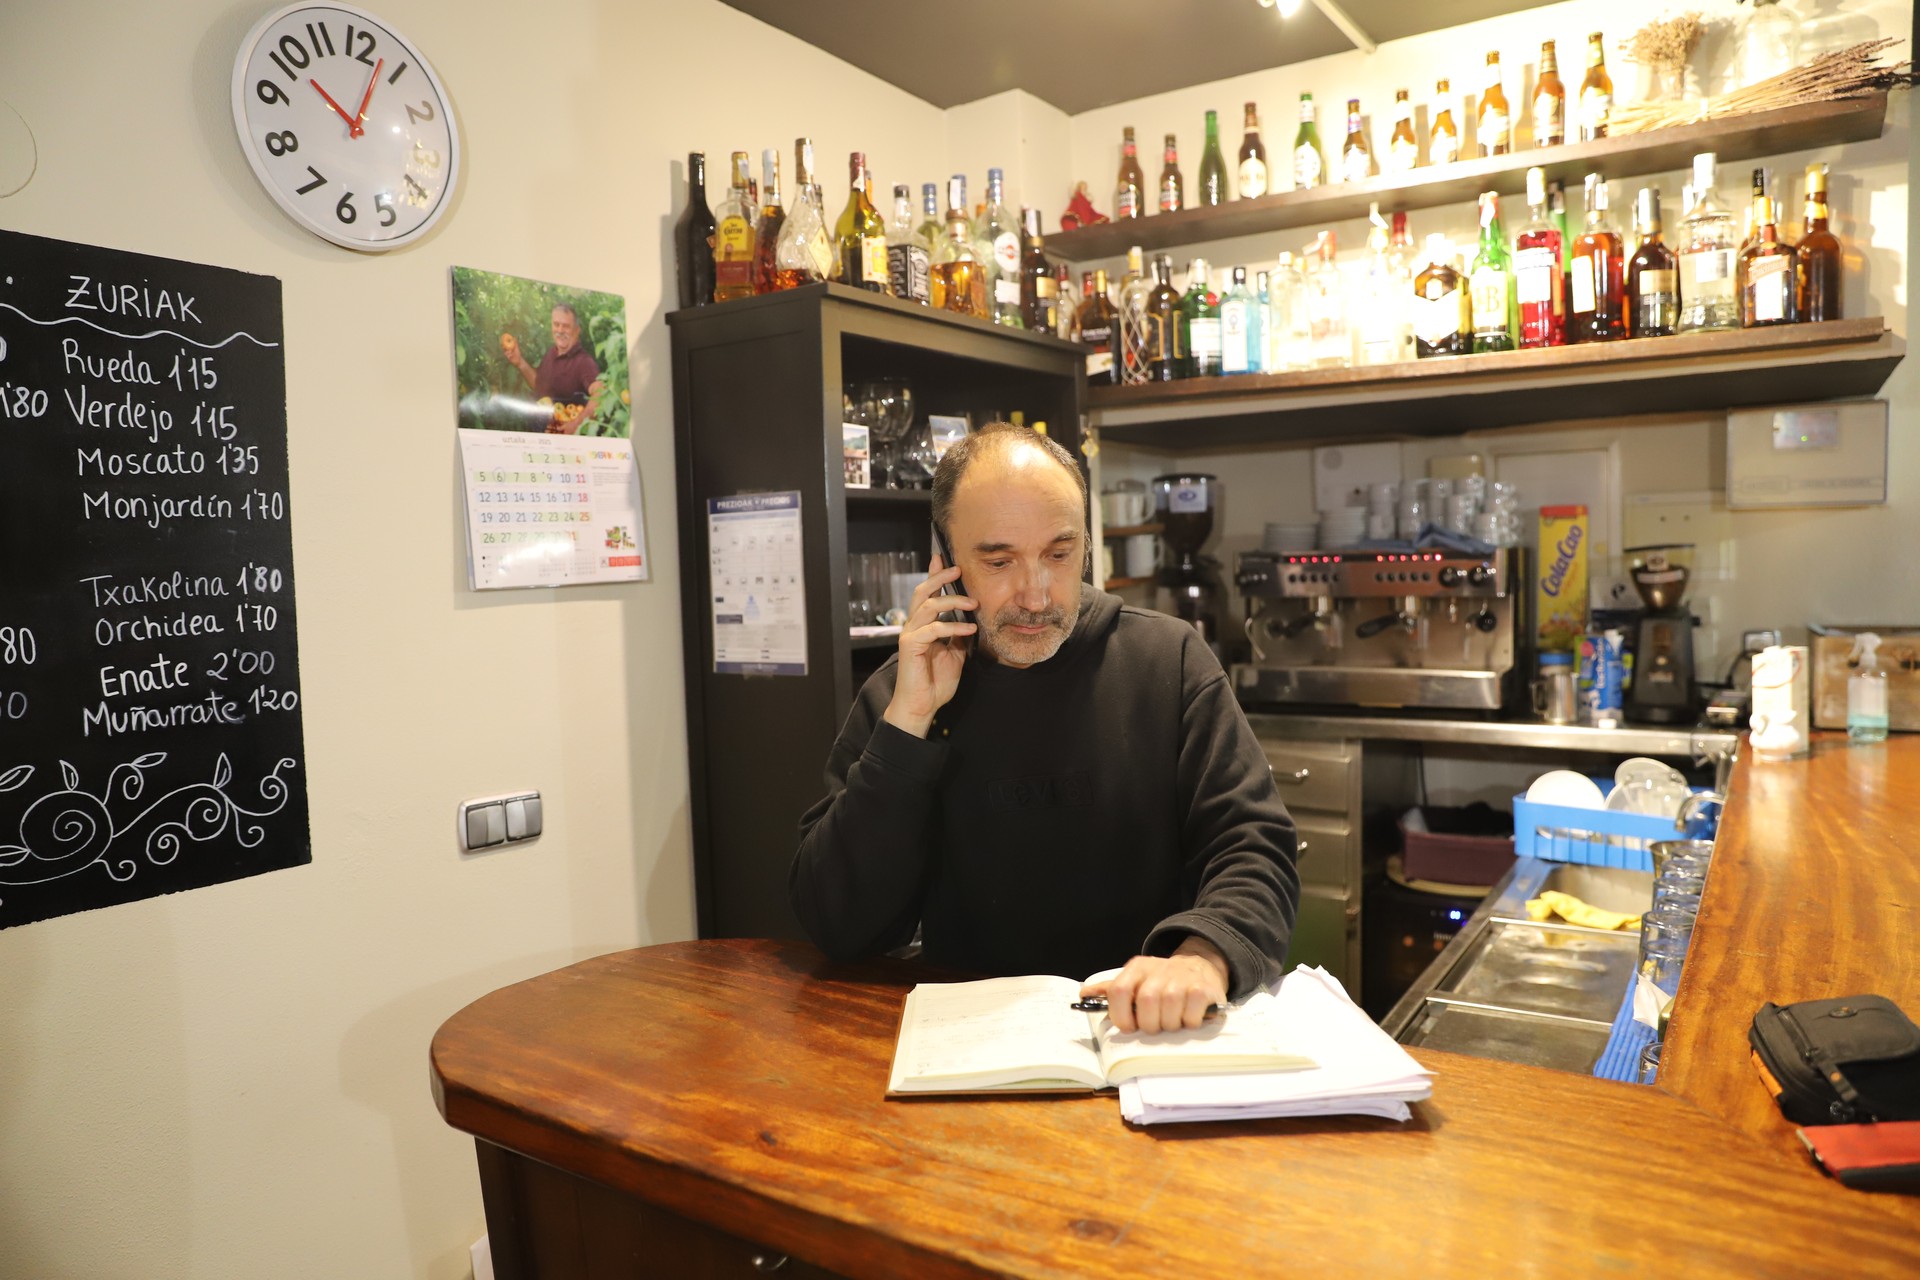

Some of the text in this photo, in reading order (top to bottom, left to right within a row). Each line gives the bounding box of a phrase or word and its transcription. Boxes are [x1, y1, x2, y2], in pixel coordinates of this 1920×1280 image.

[269, 35, 310, 81] 10
[345, 24, 376, 67] 12
[388, 61, 407, 85] 1
[256, 79, 290, 107] 9
[404, 100, 434, 125] 2
[265, 130, 299, 157] 8
[295, 165, 328, 195] 7
[336, 192, 357, 224] 6
[374, 192, 396, 227] 5
[62, 338, 217, 391] Rueda 1'15
[64, 385, 237, 443] Verdejo 1'15
[78, 444, 258, 476] Moscato 1'35
[528, 454, 534, 463] 1
[543, 454, 550, 463] 2
[560, 454, 566, 464] 3
[575, 456, 581, 464] 4
[480, 472, 486, 482] 5
[497, 472, 503, 482] 6
[513, 473, 520, 482] 7
[530, 473, 537, 482] 8
[546, 473, 552, 483] 9
[560, 474, 571, 483] 10
[576, 474, 586, 483] 11
[84, 489, 283, 528] Monjardín 1'70
[479, 492, 588, 503] 12 13 14 15 16 17 18
[481, 512, 590, 523] 19 20 21 22 23 24 25
[483, 533, 495, 543] 26
[501, 532, 511, 543] 27
[237, 562, 282, 594] 1'80
[96, 603, 277, 645] Orchidea 1'70
[101, 649, 275, 697] Enate 2'00
[84, 685, 298, 736] Muñarrate 1'20
